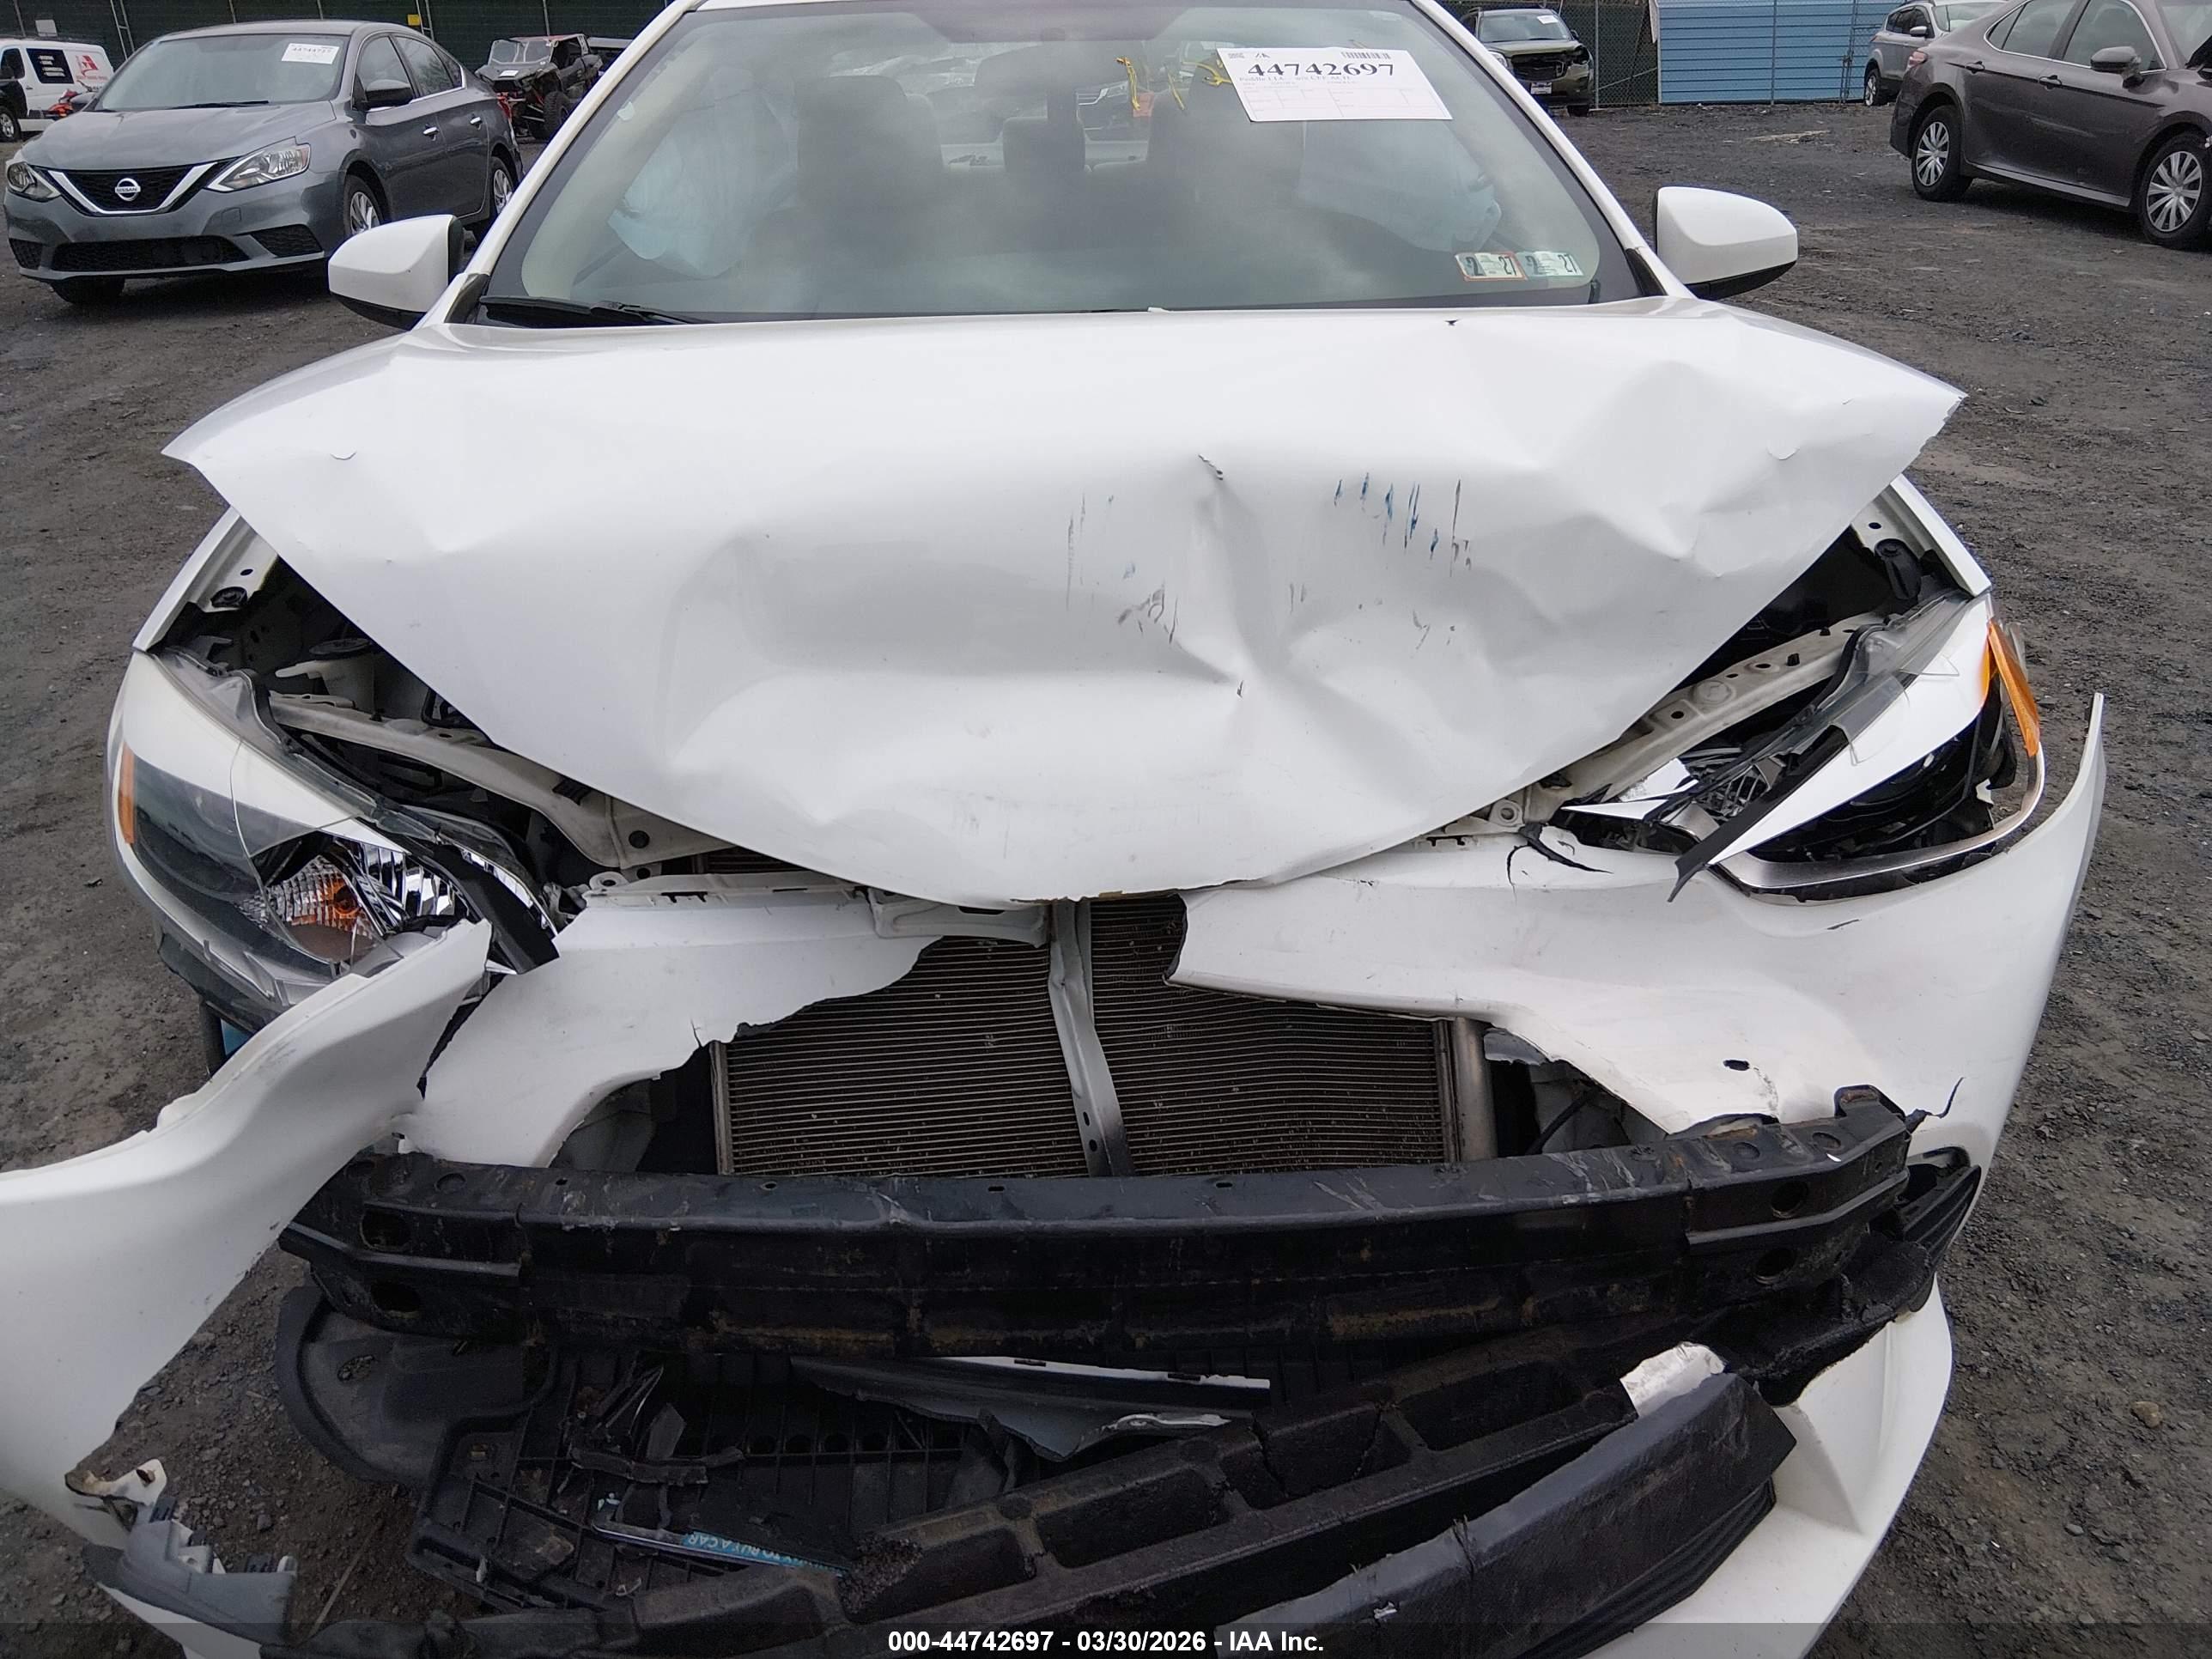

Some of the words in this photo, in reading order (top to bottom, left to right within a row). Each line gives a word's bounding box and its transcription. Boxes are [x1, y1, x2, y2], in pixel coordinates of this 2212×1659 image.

[1248, 63, 1394, 76] 44742697
[1466, 257, 1486, 276] 2
[1498, 256, 1516, 276] 27
[1558, 254, 1577, 273] 27
[689, 1534, 719, 1548] CAR
[722, 1540, 732, 1549] A
